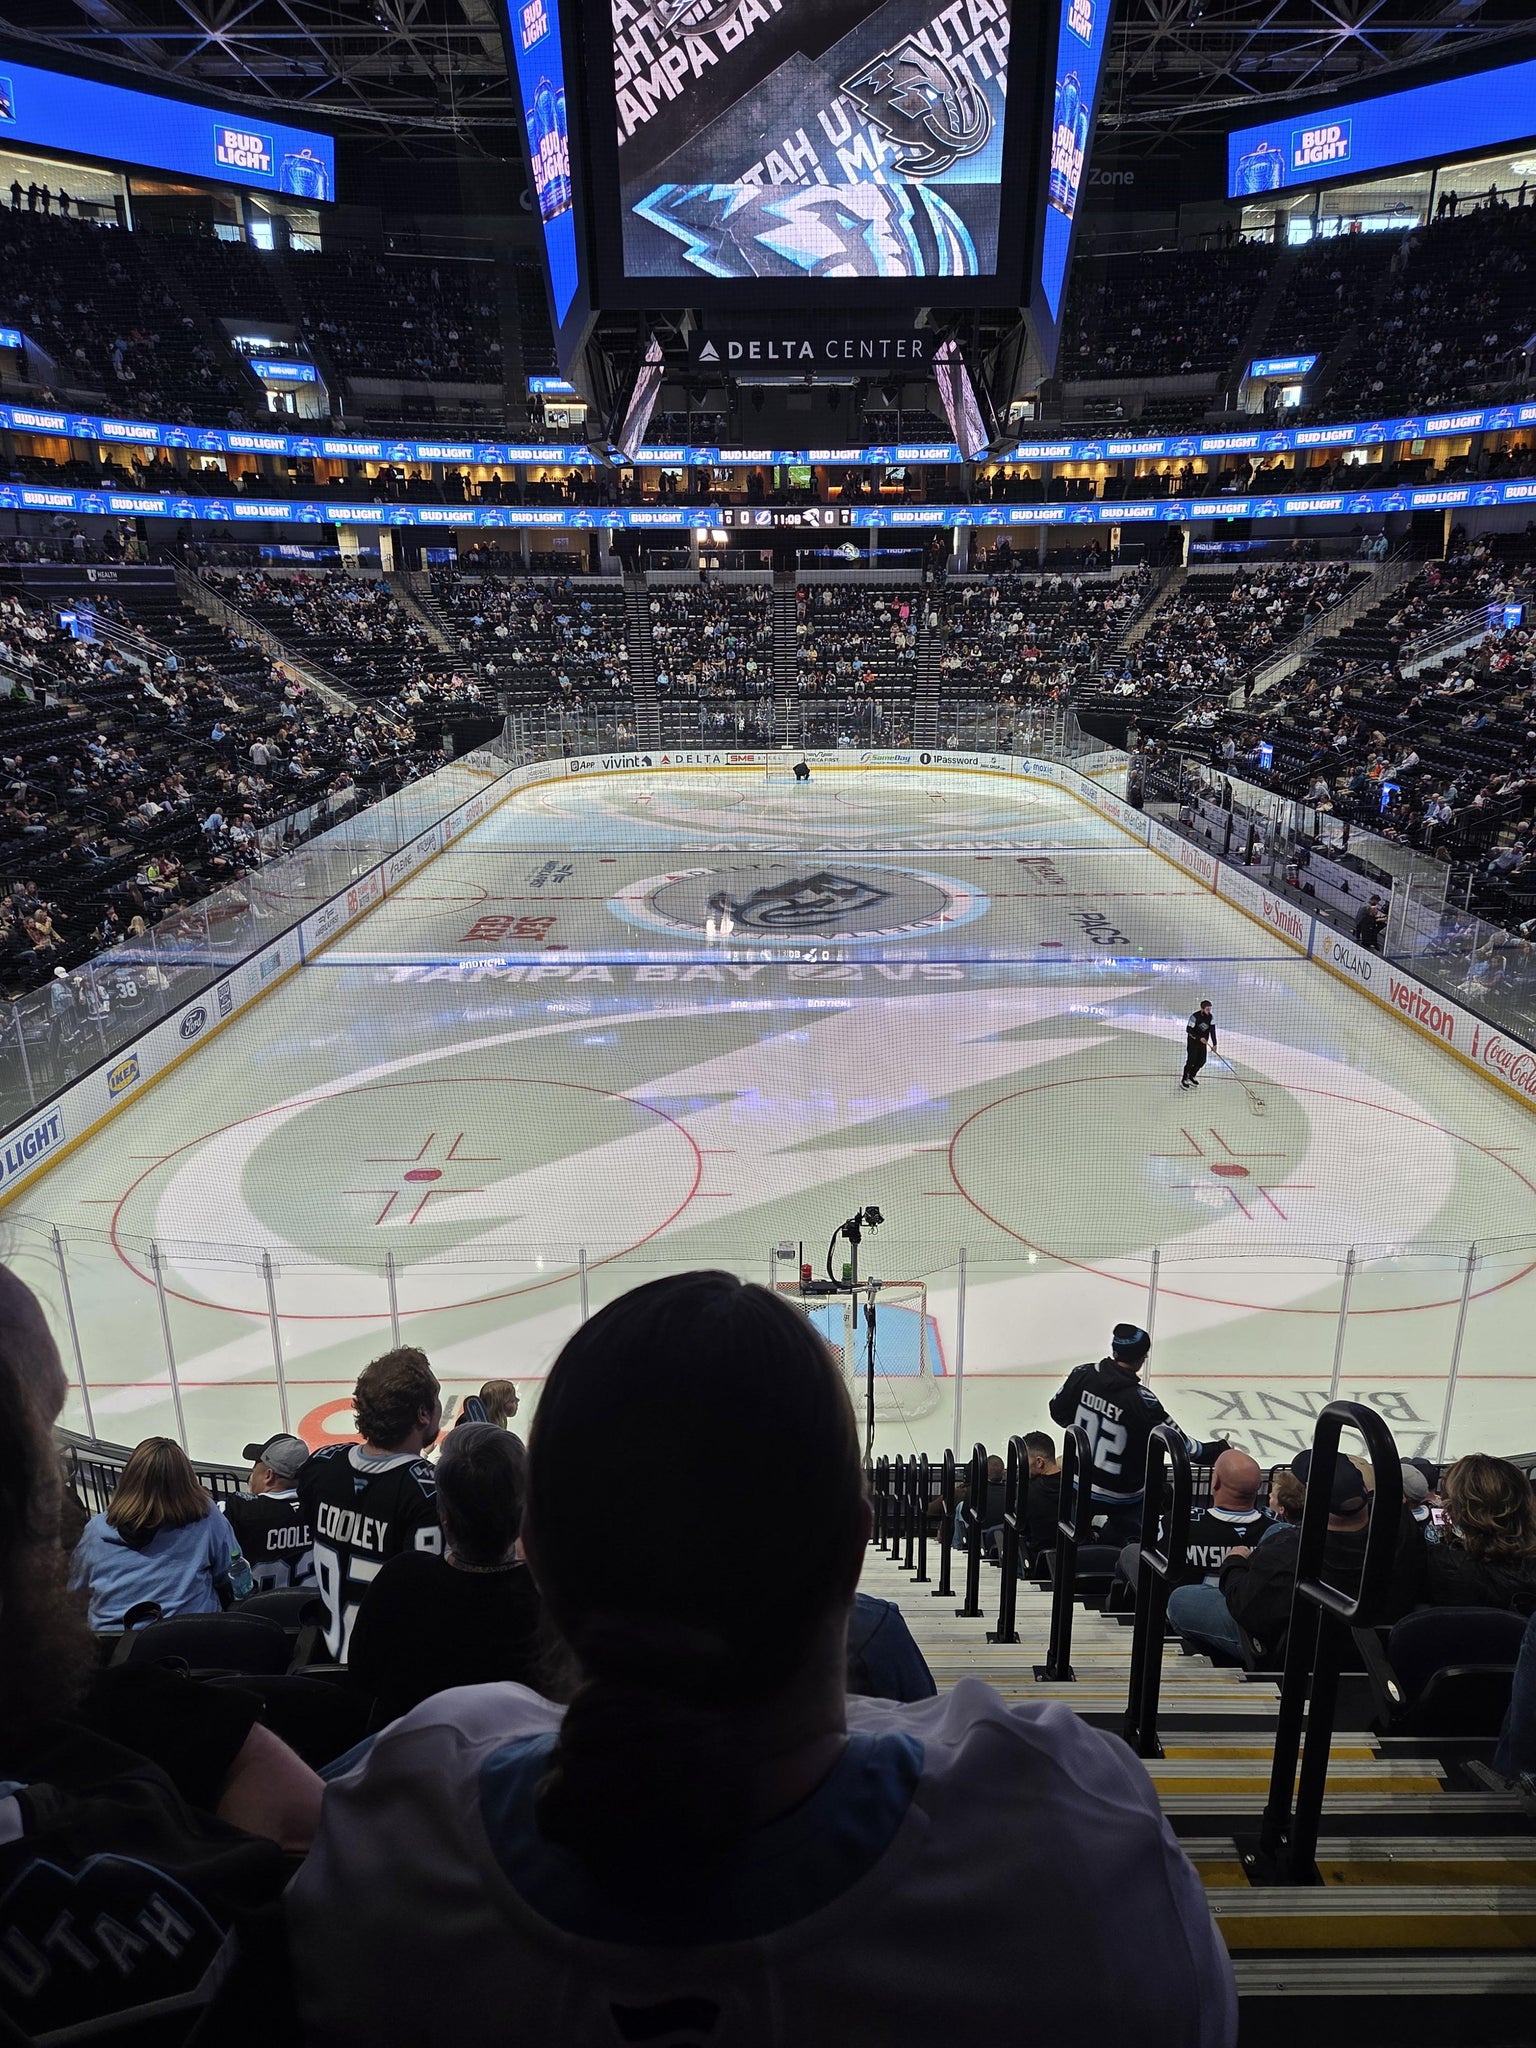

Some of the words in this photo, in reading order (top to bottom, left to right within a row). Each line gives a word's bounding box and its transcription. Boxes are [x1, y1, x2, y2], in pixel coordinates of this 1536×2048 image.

[523, 0, 543, 26] BUD
[1068, 7, 1092, 41] LIGHT
[522, 16, 548, 50] LIGHT
[615, 45, 720, 147] AMPA
[224, 130, 263, 153] BUD
[1302, 126, 1341, 149] BUD
[217, 145, 270, 171] LIGHT
[1294, 140, 1347, 167] LIGHT
[1089, 168, 1134, 186] Zone
[728, 341, 815, 359] DELTA
[826, 339, 923, 359] CENTER
[14, 412, 38, 425] BUD
[37, 415, 66, 429] LIGHT
[1427, 419, 1451, 431] BUD
[1450, 415, 1483, 429] LIGHT
[103, 424, 126, 436] BUD
[125, 426, 158, 439] LIGHT
[1297, 433, 1320, 444] BUD
[1320, 429, 1354, 442] LIGHT
[230, 436, 253, 448] BUD
[252, 438, 286, 450] LIGHT
[325, 442, 348, 453] BUD
[348, 444, 380, 454] LIGHT
[1109, 444, 1131, 454] BUD
[1131, 443, 1163, 453] LIGHT
[1203, 440, 1225, 450] BUD
[1225, 437, 1258, 448] LIGHT
[418, 447, 443, 457] BUD
[442, 448, 472, 458] LIGHT
[510, 449, 534, 459] BUD
[533, 450, 563, 460] LIGHT
[653, 450, 684, 460] LIGHT
[720, 451, 742, 460] BUD
[743, 450, 772, 460] LIGHT
[809, 450, 830, 459] BUD
[829, 450, 860, 459] LIGHT
[898, 449, 919, 459] BUD
[919, 448, 950, 458] LIGHT
[1018, 448, 1040, 457] BUD
[1039, 446, 1071, 456] LIGHT
[1413, 493, 1437, 504] BUD
[1436, 490, 1468, 503] LIGHT
[1506, 486, 1528, 498] BUD
[24, 493, 45, 504] BUD
[44, 495, 74, 506] LIGHT
[112, 499, 133, 510] BUD
[133, 500, 165, 511] LIGHT
[1287, 501, 1310, 511] BUD
[1309, 499, 1341, 510] LIGHT
[235, 505, 259, 516] BUD
[259, 506, 290, 517] LIGHT
[328, 508, 350, 519] BUD
[350, 509, 382, 520] LIGHT
[1011, 510, 1034, 520] BUD
[1034, 509, 1064, 519] LIGHT
[1102, 508, 1124, 518] BUD
[1124, 507, 1155, 517] LIGHT
[1193, 505, 1216, 514] BUD
[1215, 503, 1247, 514] LIGHT
[420, 511, 443, 521] BUD
[443, 511, 474, 521] LIGHT
[511, 512, 534, 522] BUD
[534, 513, 563, 522] LIGHT
[631, 513, 653, 523] BUD
[653, 513, 682, 523] LIGHT
[740, 511, 750, 525] 0
[824, 511, 834, 524] 0
[892, 512, 913, 522] BUD
[912, 511, 943, 521] LIGHT
[98, 570, 118, 578] HEALTH
[602, 755, 640, 770] vivint
[675, 754, 721, 764] DELTA
[933, 754, 979, 766] 1Password
[1271, 898, 1304, 942] Smith's
[1069, 913, 1131, 945] PACS
[1333, 943, 1372, 981] OKLAND
[391, 965, 616, 983] TAMPA
[633, 964, 772, 983] BAY
[115, 981, 138, 999] 38
[1389, 977, 1455, 1041] verizon
[110, 1061, 138, 1089] IKEA
[6, 1115, 59, 1175] LIGHT
[1081, 1389, 1124, 1423] COOLEY
[316, 1501, 389, 1553] COOLEY
[266, 1524, 313, 1551] COOLE
[0, 1892, 196, 1998] UTAH
